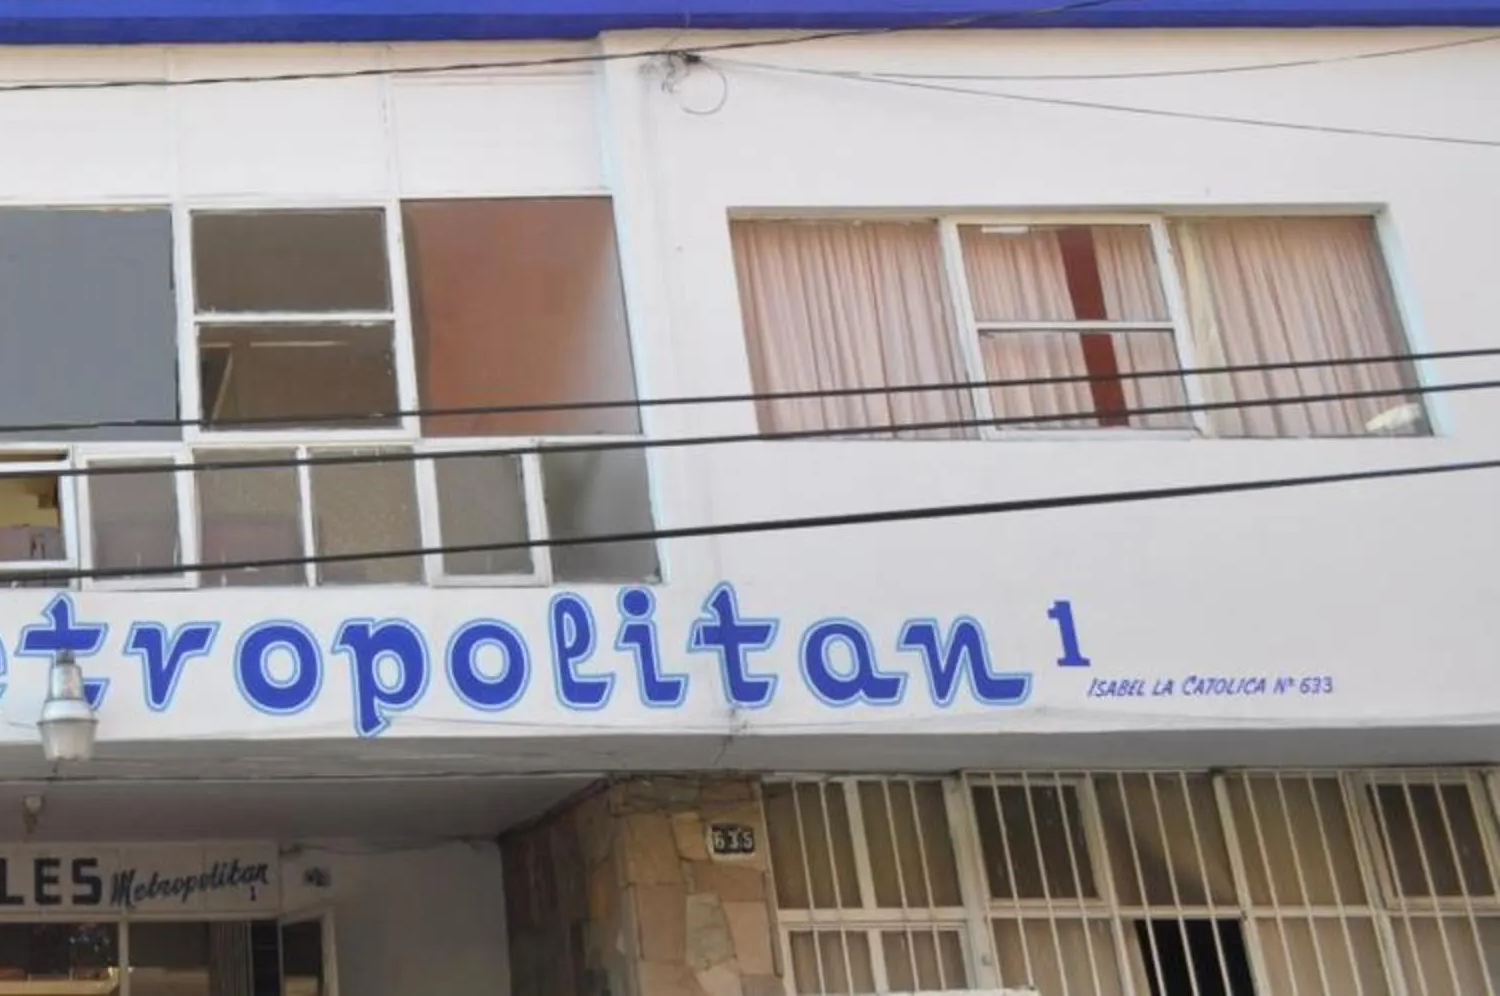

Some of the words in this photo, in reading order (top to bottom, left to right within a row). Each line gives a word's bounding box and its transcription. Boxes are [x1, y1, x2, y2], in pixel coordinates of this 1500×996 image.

[1047, 600, 1091, 667] 1
[1087, 677, 1146, 697] ISABEL
[1152, 678, 1173, 696] LA
[1182, 675, 1266, 696] CATOLICA
[111, 859, 270, 908] Metropolitan
